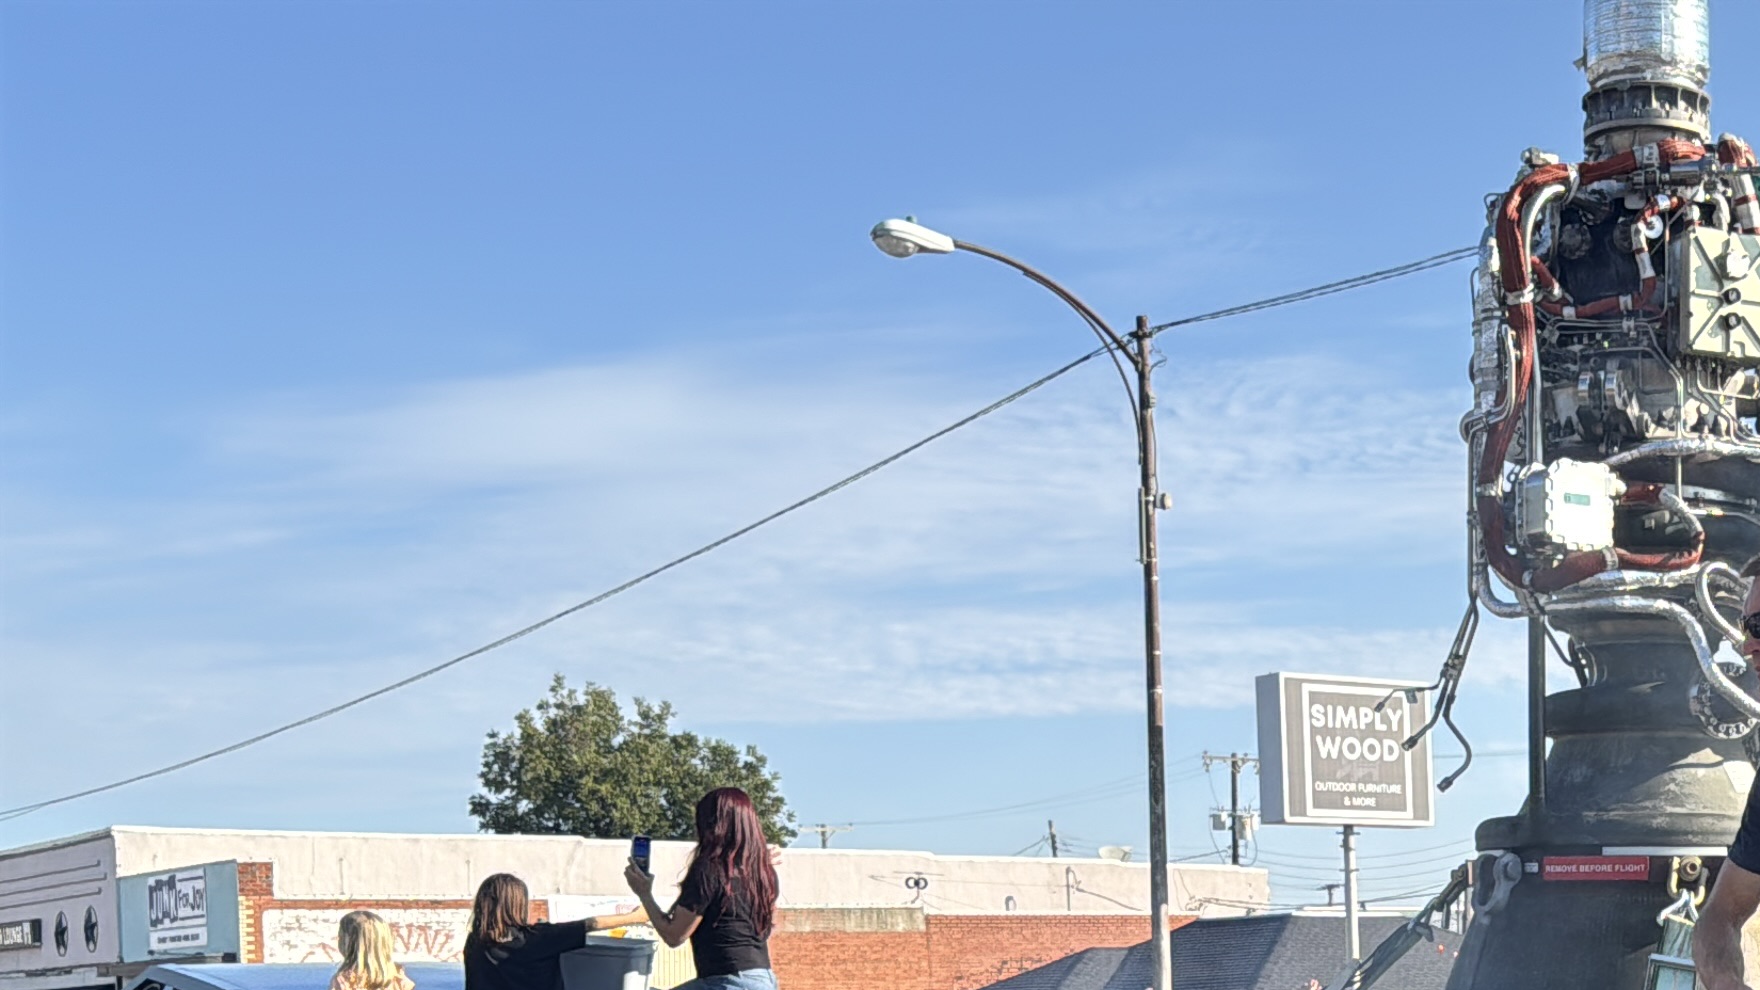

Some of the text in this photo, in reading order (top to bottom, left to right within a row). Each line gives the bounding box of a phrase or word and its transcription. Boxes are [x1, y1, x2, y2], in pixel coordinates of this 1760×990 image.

[1311, 703, 1402, 732] SIMPLY
[1315, 734, 1400, 762] WOOD
[1314, 781, 1402, 794] OUTDOOR FURNITURE
[1343, 796, 1376, 807] & MORE
[1545, 864, 1577, 873] REMOVE
[1579, 864, 1613, 873] BEFORE
[1615, 863, 1646, 873] FLIGHT
